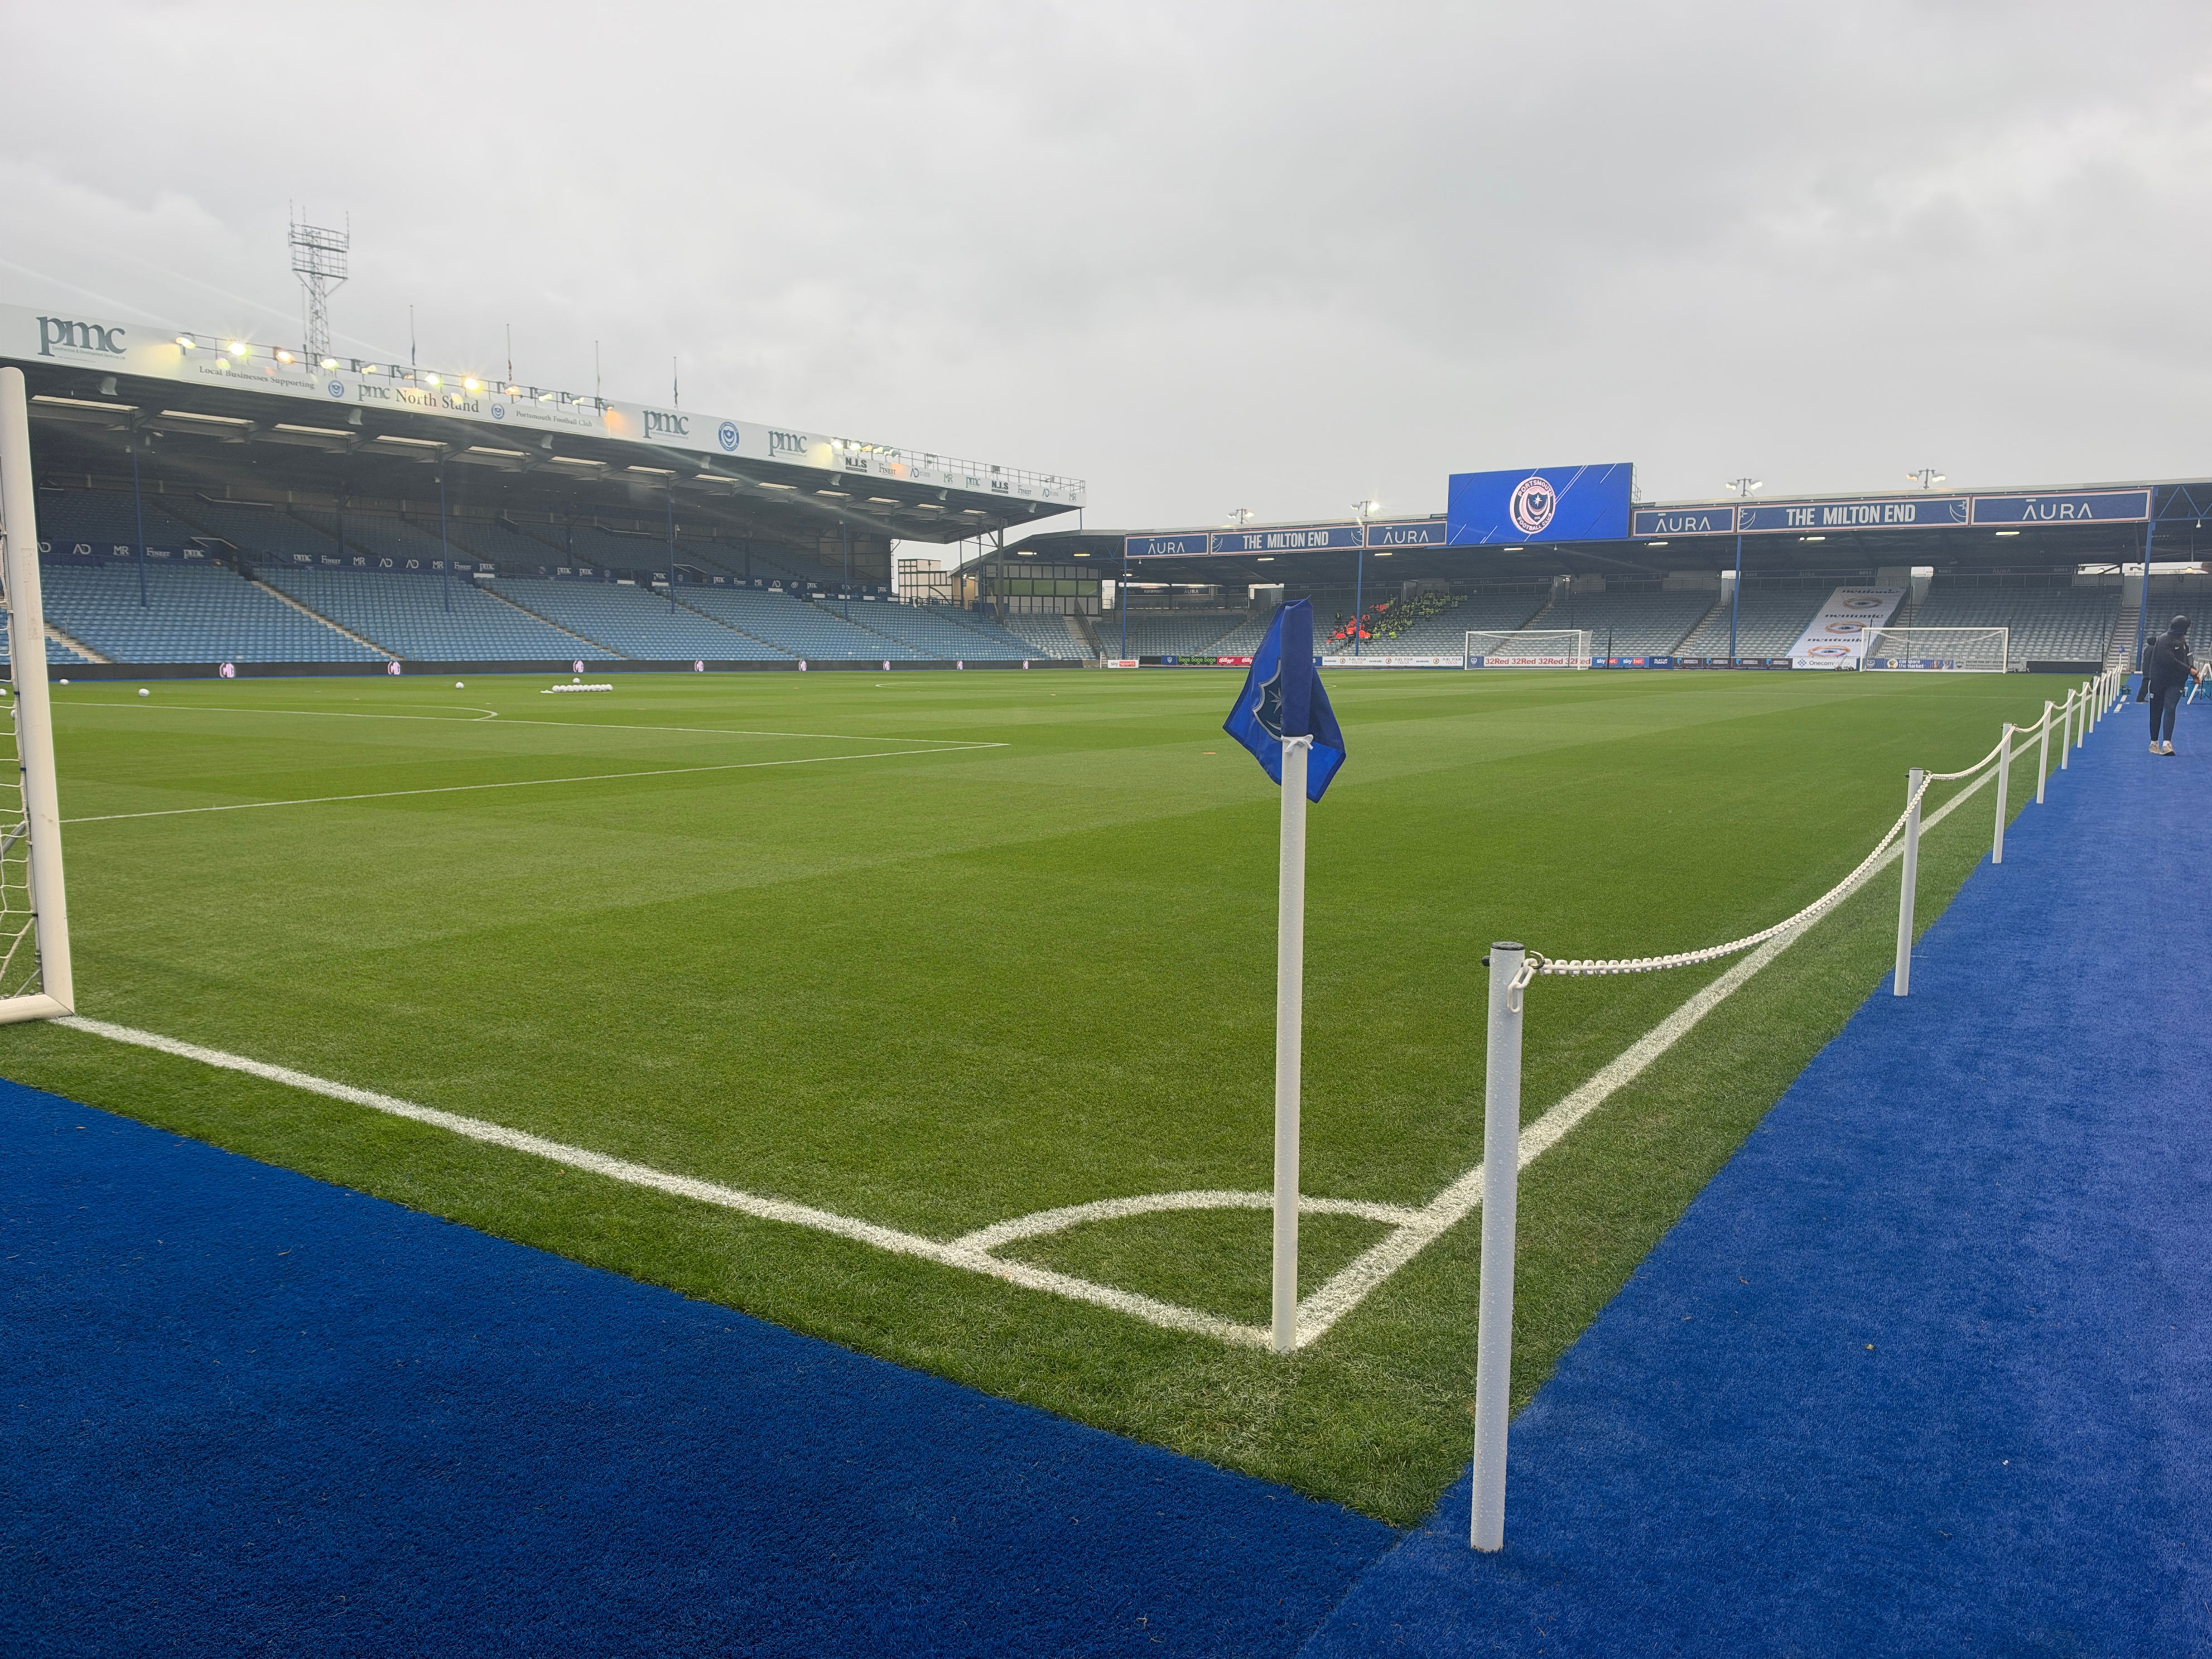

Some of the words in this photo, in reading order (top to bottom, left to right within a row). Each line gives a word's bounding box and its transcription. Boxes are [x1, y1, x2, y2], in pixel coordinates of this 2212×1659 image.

[36, 316, 127, 357] pmc
[199, 366, 222, 375] Local
[225, 368, 268, 382] Businesses
[270, 377, 315, 390] Supporting
[357, 384, 391, 402] pmc
[396, 389, 437, 407] North
[441, 396, 480, 413] Stand
[516, 411, 552, 422] Portsmouth
[553, 416, 577, 425] Football
[642, 410, 690, 438] pmc
[768, 431, 807, 457] pmc
[943, 473, 953, 483] MR
[966, 476, 980, 488] pmc
[1517, 480, 1553, 498] PORTSMOUTH
[1786, 508, 1815, 526] THE
[1823, 505, 1880, 525] MILTON
[1885, 504, 1916, 523] END
[1517, 516, 1541, 531] FOOTBALL
[1541, 513, 1553, 526] CLUB
[1242, 534, 1262, 549] THE
[1267, 532, 1305, 549] MILTON
[1308, 531, 1329, 546] END
[113, 546, 129, 555] MR
[183, 549, 204, 559] pmc
[293, 554, 312, 563] pmc
[353, 557, 365, 566] MR
[432, 561, 444, 570] MR
[479, 563, 495, 572] pmc
[557, 567, 572, 575] pmc
[579, 568, 594, 576] pmc
[713, 576, 725, 585] pmc
